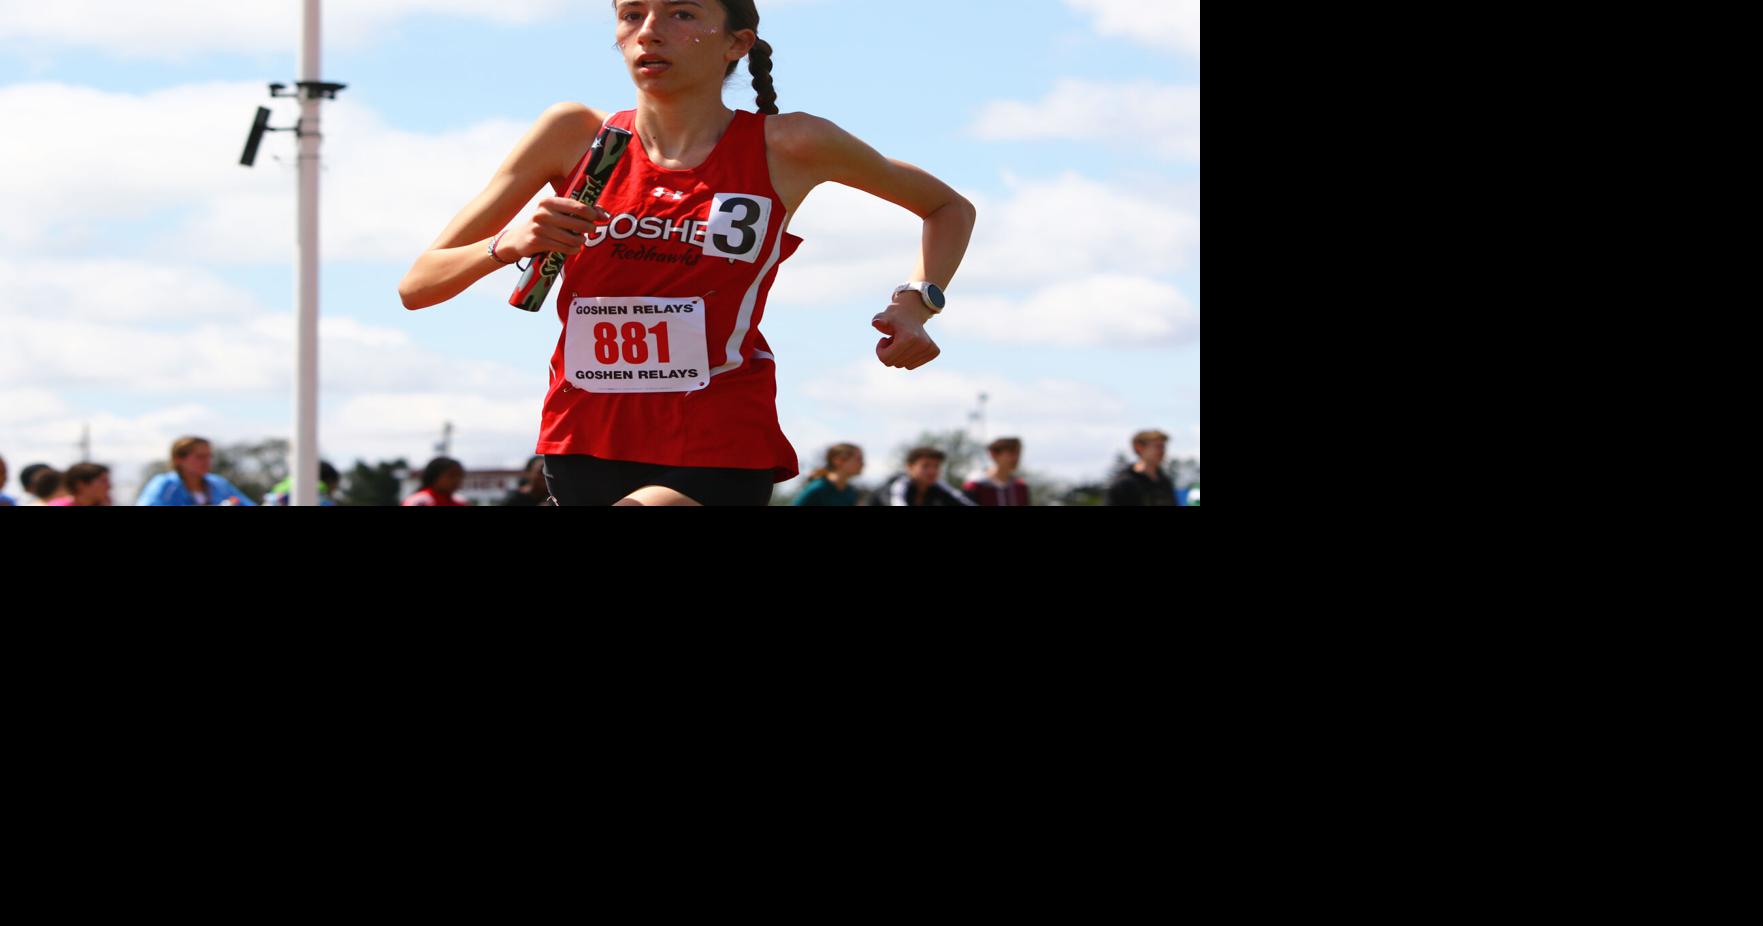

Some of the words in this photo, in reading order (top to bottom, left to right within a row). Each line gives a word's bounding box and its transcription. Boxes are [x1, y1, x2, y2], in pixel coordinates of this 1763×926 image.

[583, 213, 709, 248] GOSHE
[712, 197, 761, 255] 3
[575, 305, 628, 315] GOSHEN
[632, 304, 694, 314] RELAYS
[593, 321, 671, 365] 881
[575, 370, 633, 380] GOSHEN
[638, 369, 699, 380] RELAYS
